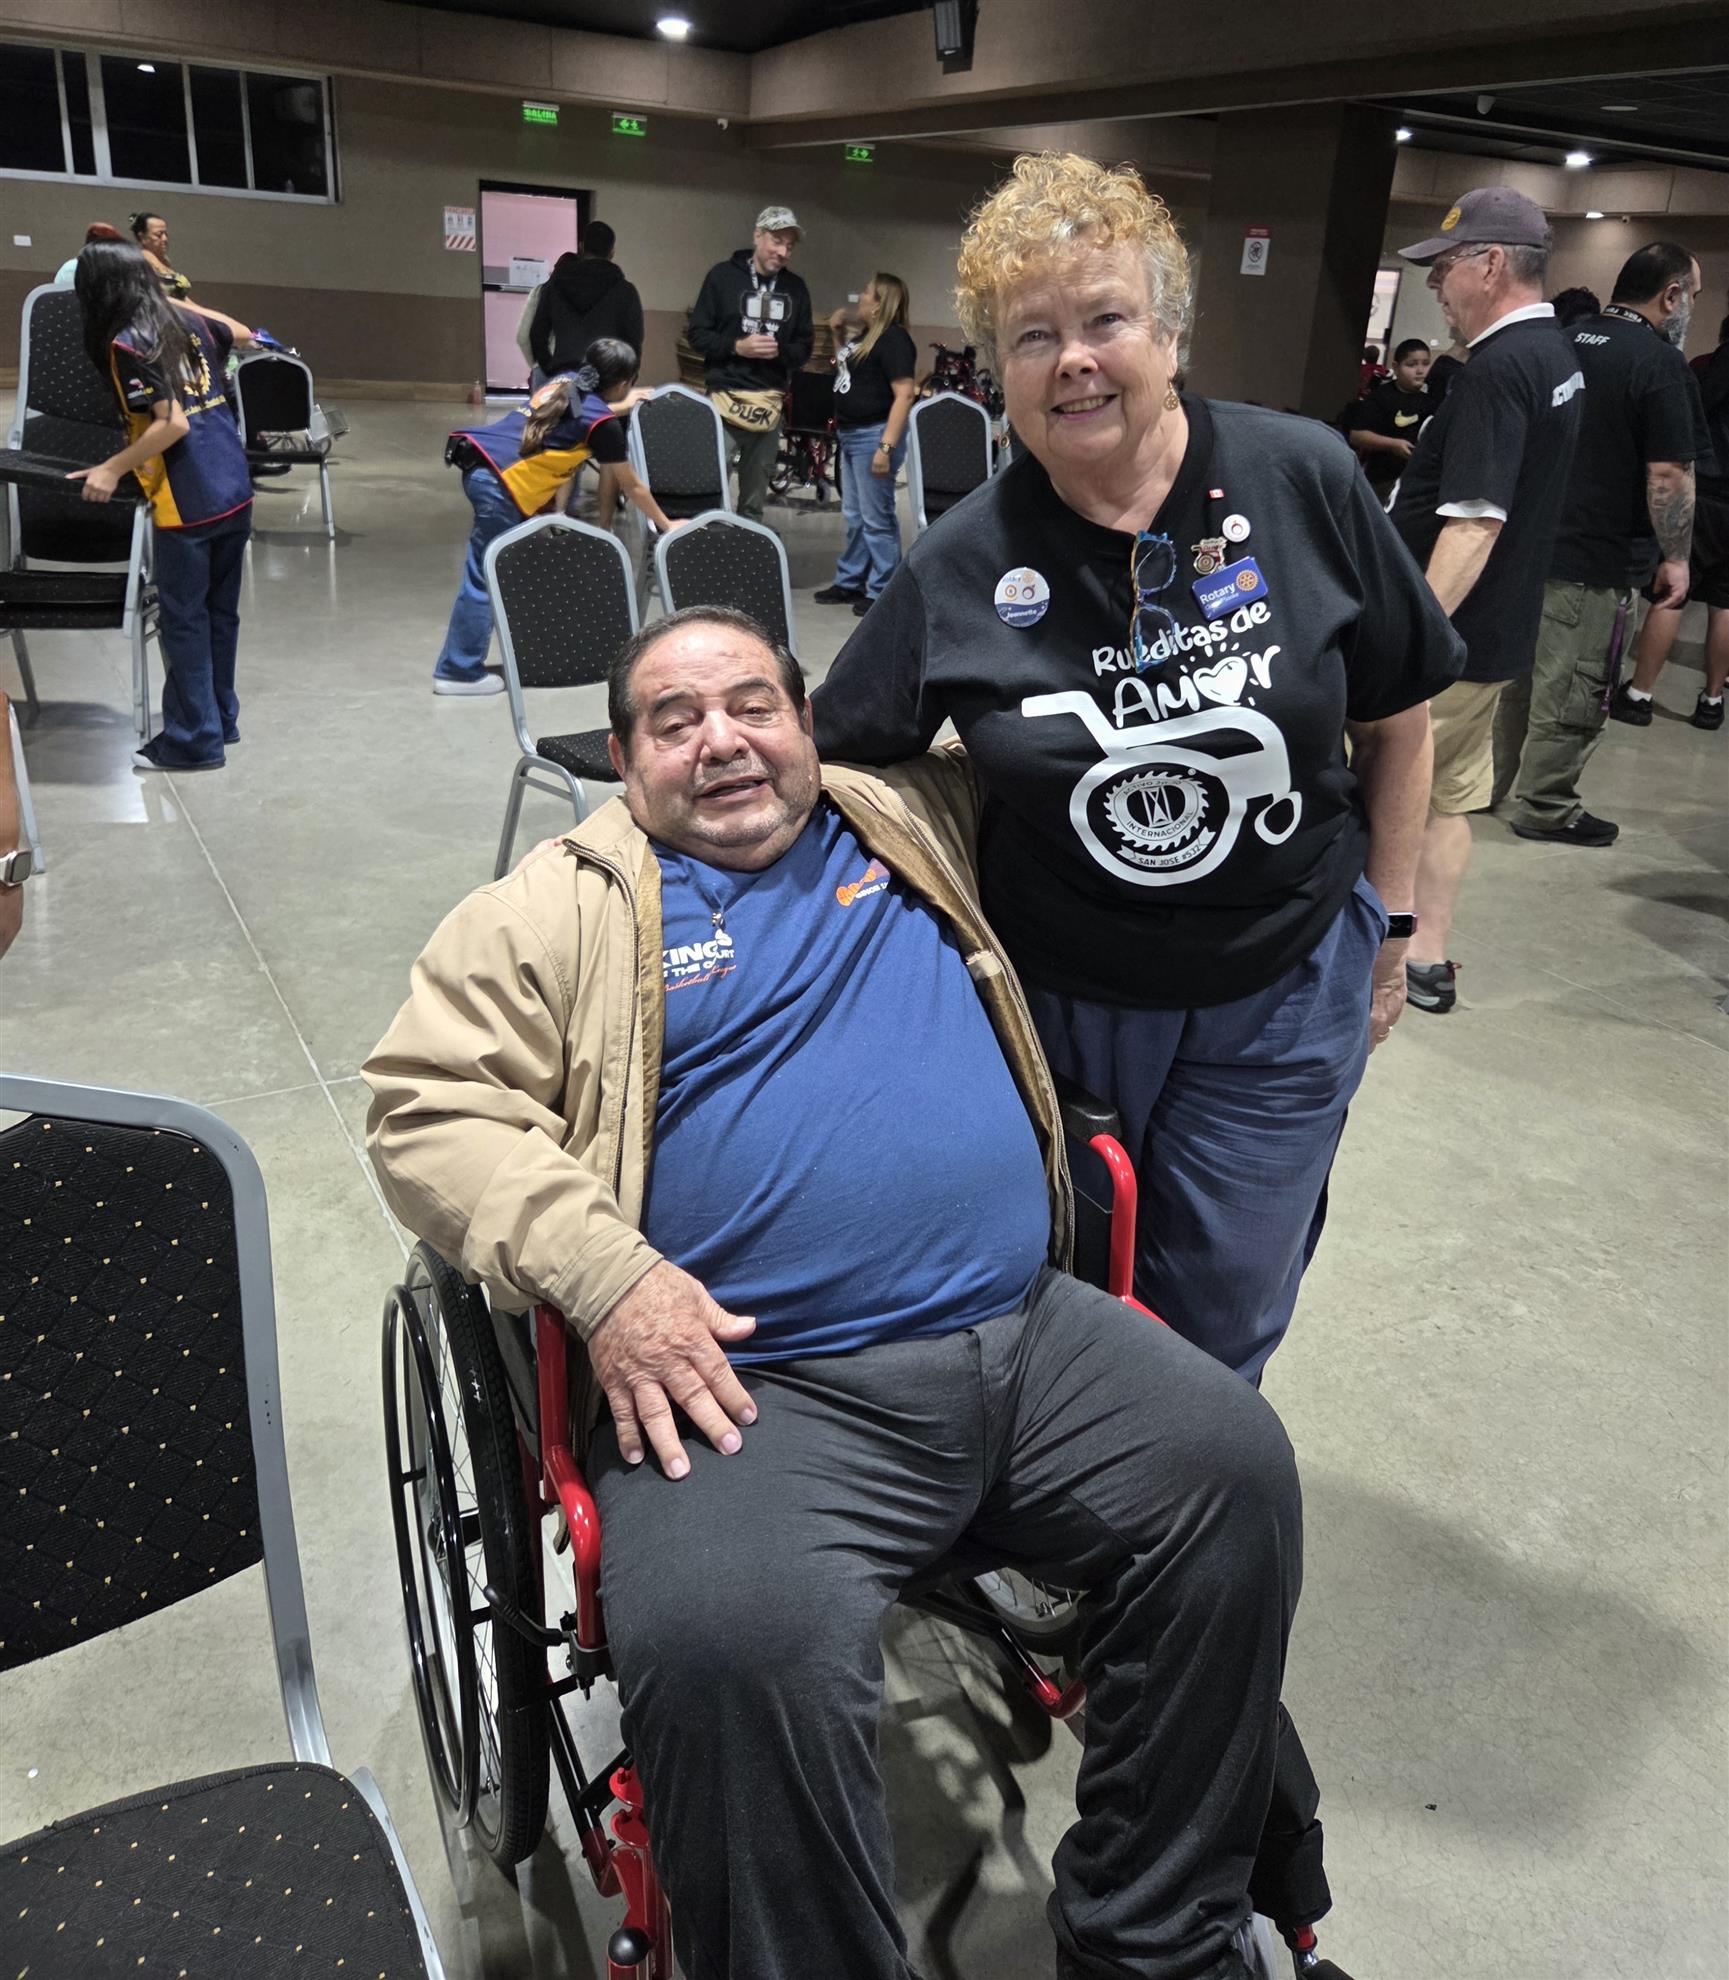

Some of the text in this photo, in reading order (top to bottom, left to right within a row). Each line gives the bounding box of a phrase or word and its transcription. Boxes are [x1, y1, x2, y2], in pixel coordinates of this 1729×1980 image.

[1574, 332, 1611, 346] STAFF
[730, 401, 772, 426] DUSK
[1200, 583, 1236, 604] Rotary
[1230, 601, 1272, 633] de
[1126, 811, 1193, 837] INTERNACIONAL
[1139, 857, 1156, 866] SAN
